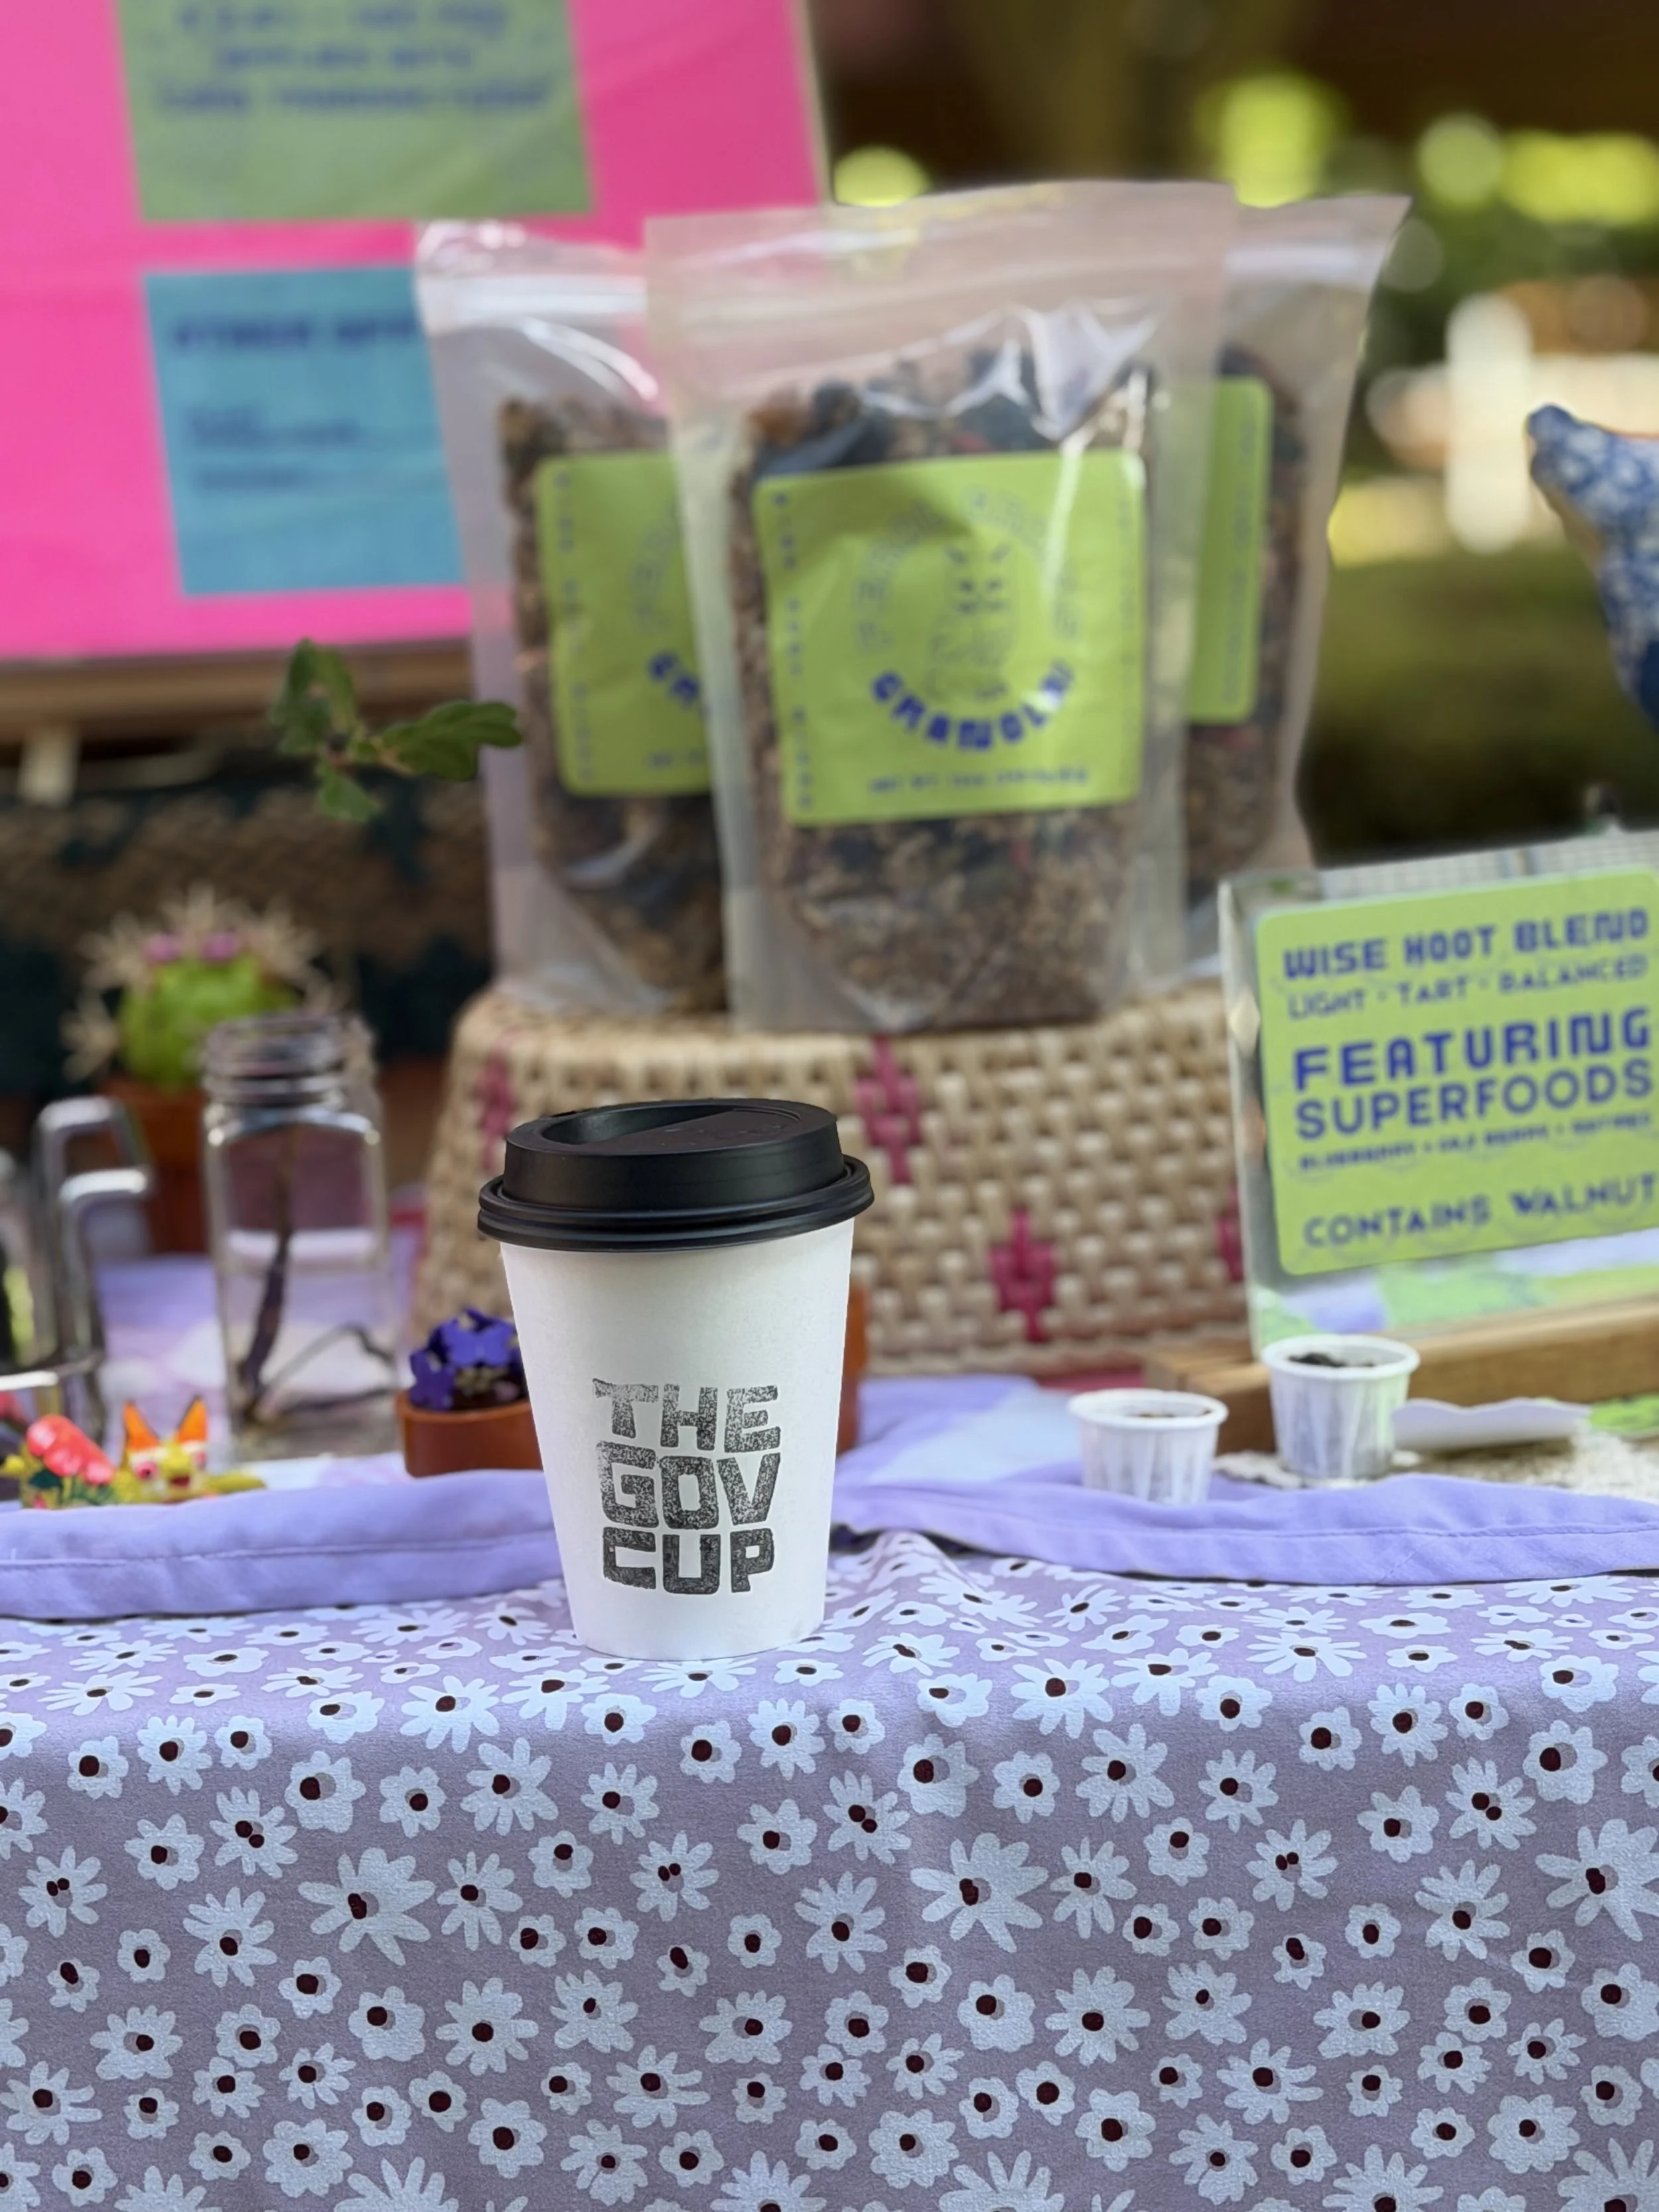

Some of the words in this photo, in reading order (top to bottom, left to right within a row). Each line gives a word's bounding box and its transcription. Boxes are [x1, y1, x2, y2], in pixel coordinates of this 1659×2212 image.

[1284, 937, 1387, 980] WISE
[1404, 925, 1497, 968] HOOT
[1514, 907, 1648, 953] BLEND
[1293, 1006, 1652, 1092] FEATURING
[1295, 1059, 1653, 1141] SUPERFOODS
[1303, 1194, 1490, 1248] CONTAINS
[593, 1378, 781, 1453] THE
[597, 1441, 781, 1530] GOV
[603, 1527, 776, 1595] CUP
